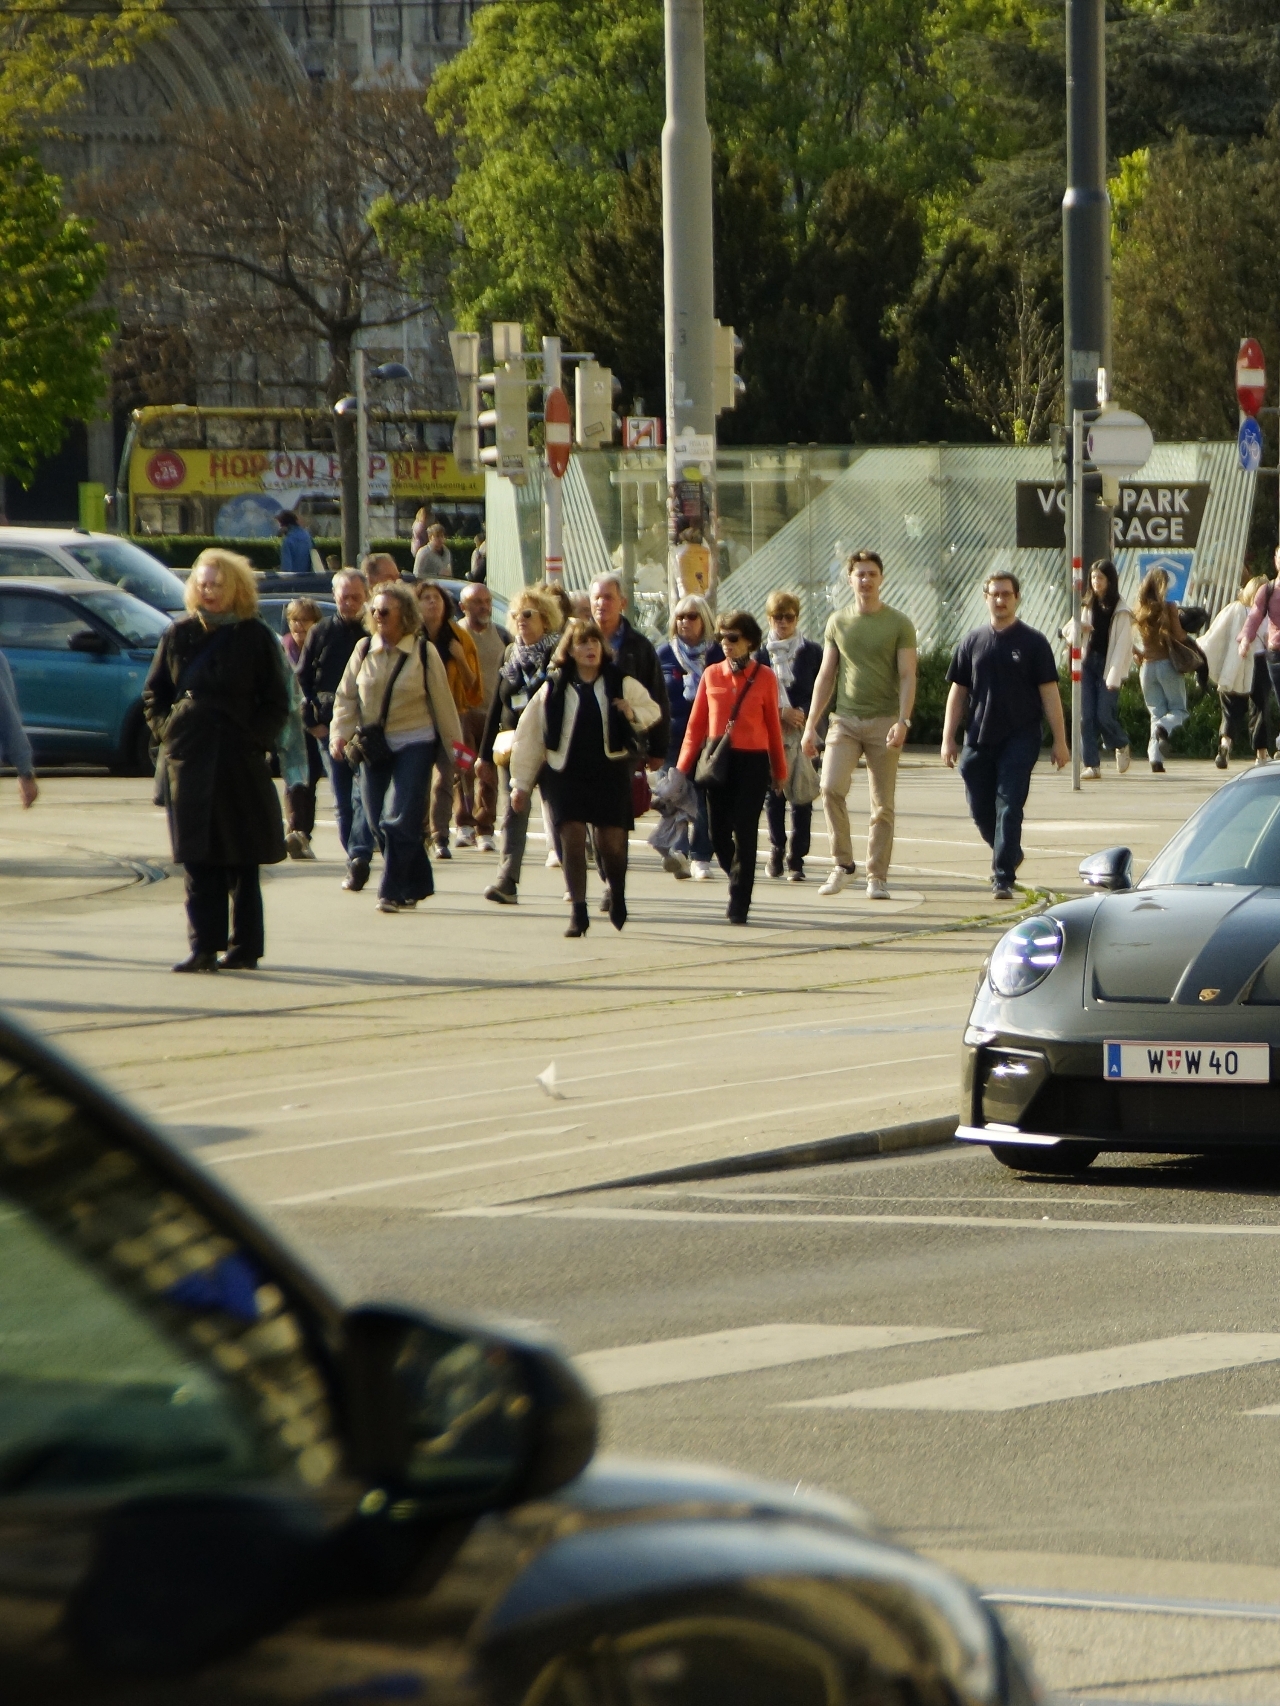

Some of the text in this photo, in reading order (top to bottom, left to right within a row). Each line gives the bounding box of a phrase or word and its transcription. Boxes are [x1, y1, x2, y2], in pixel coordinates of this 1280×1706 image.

[209, 454, 447, 480] HOP ON HP OFF
[1111, 517, 1183, 541] RAGE
